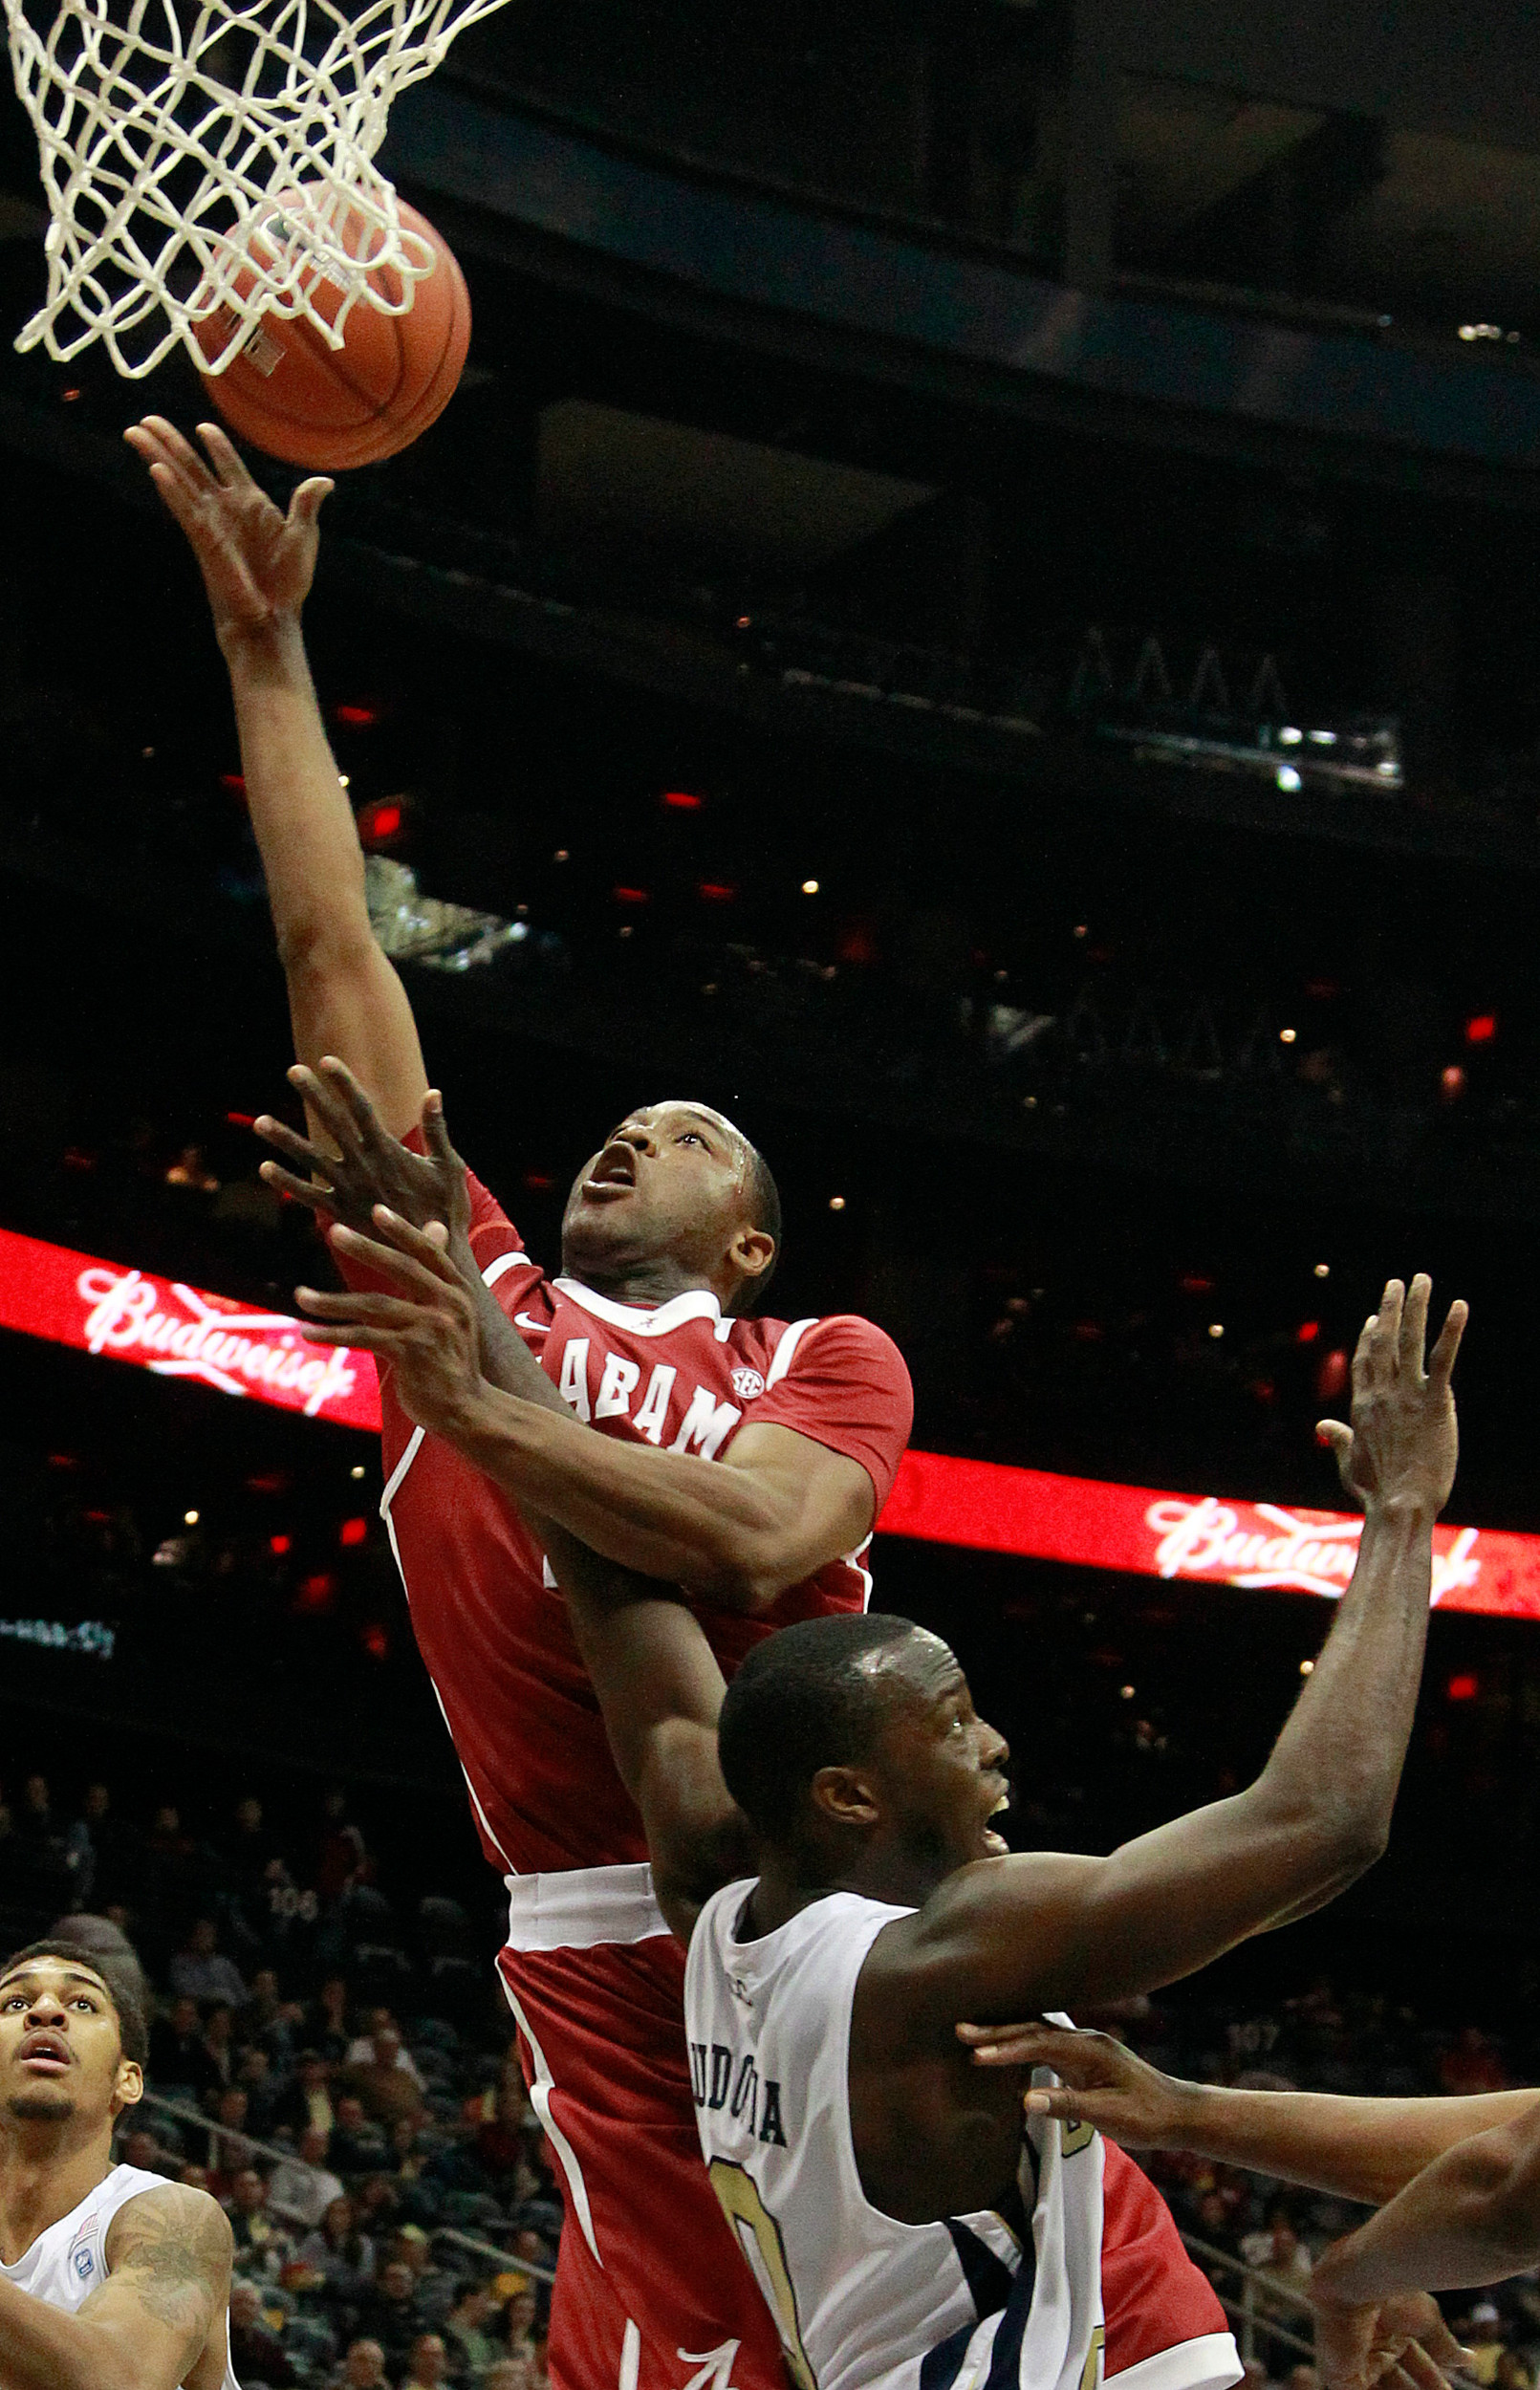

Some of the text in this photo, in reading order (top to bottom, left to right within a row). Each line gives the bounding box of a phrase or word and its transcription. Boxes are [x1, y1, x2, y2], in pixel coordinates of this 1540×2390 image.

[77, 1269, 357, 1416] Budweiser
[535, 1338, 743, 1461] ABAM
[732, 1371, 762, 1396] SEC
[1146, 1497, 1481, 1606] Budwr
